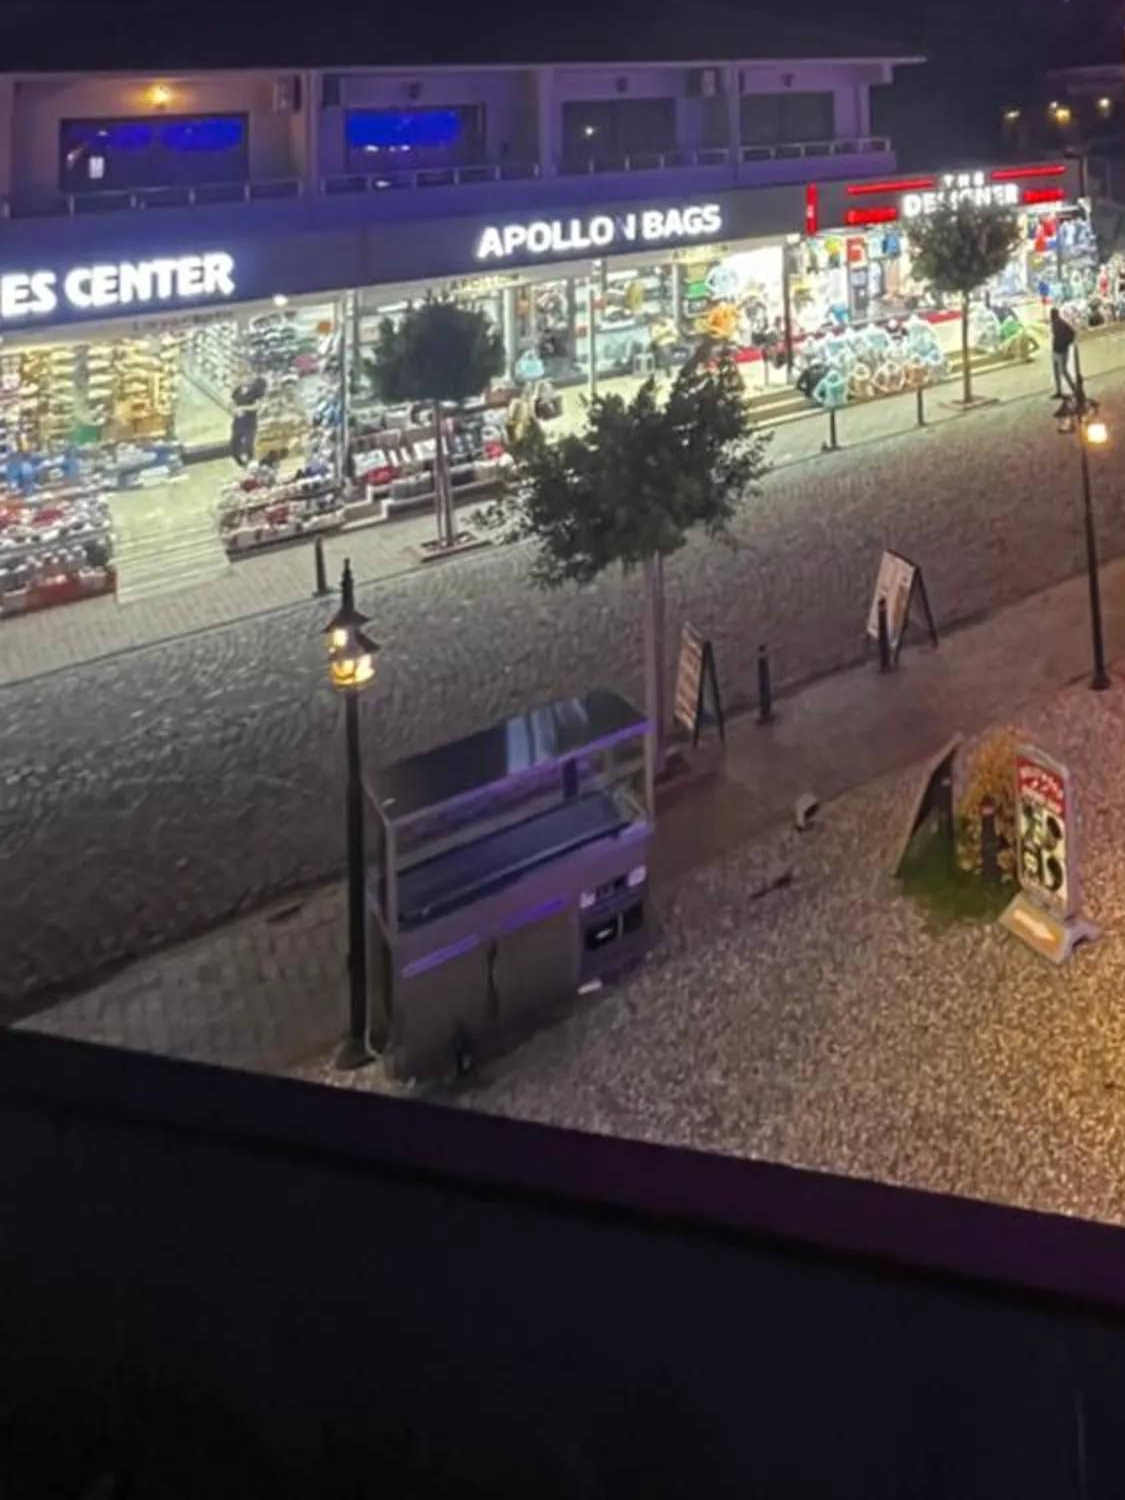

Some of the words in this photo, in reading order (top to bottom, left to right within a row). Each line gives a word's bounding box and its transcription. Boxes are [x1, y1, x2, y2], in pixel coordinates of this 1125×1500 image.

[641, 203, 723, 241] BAGS
[0, 270, 57, 319] ES
[63, 251, 236, 309] CENTER
